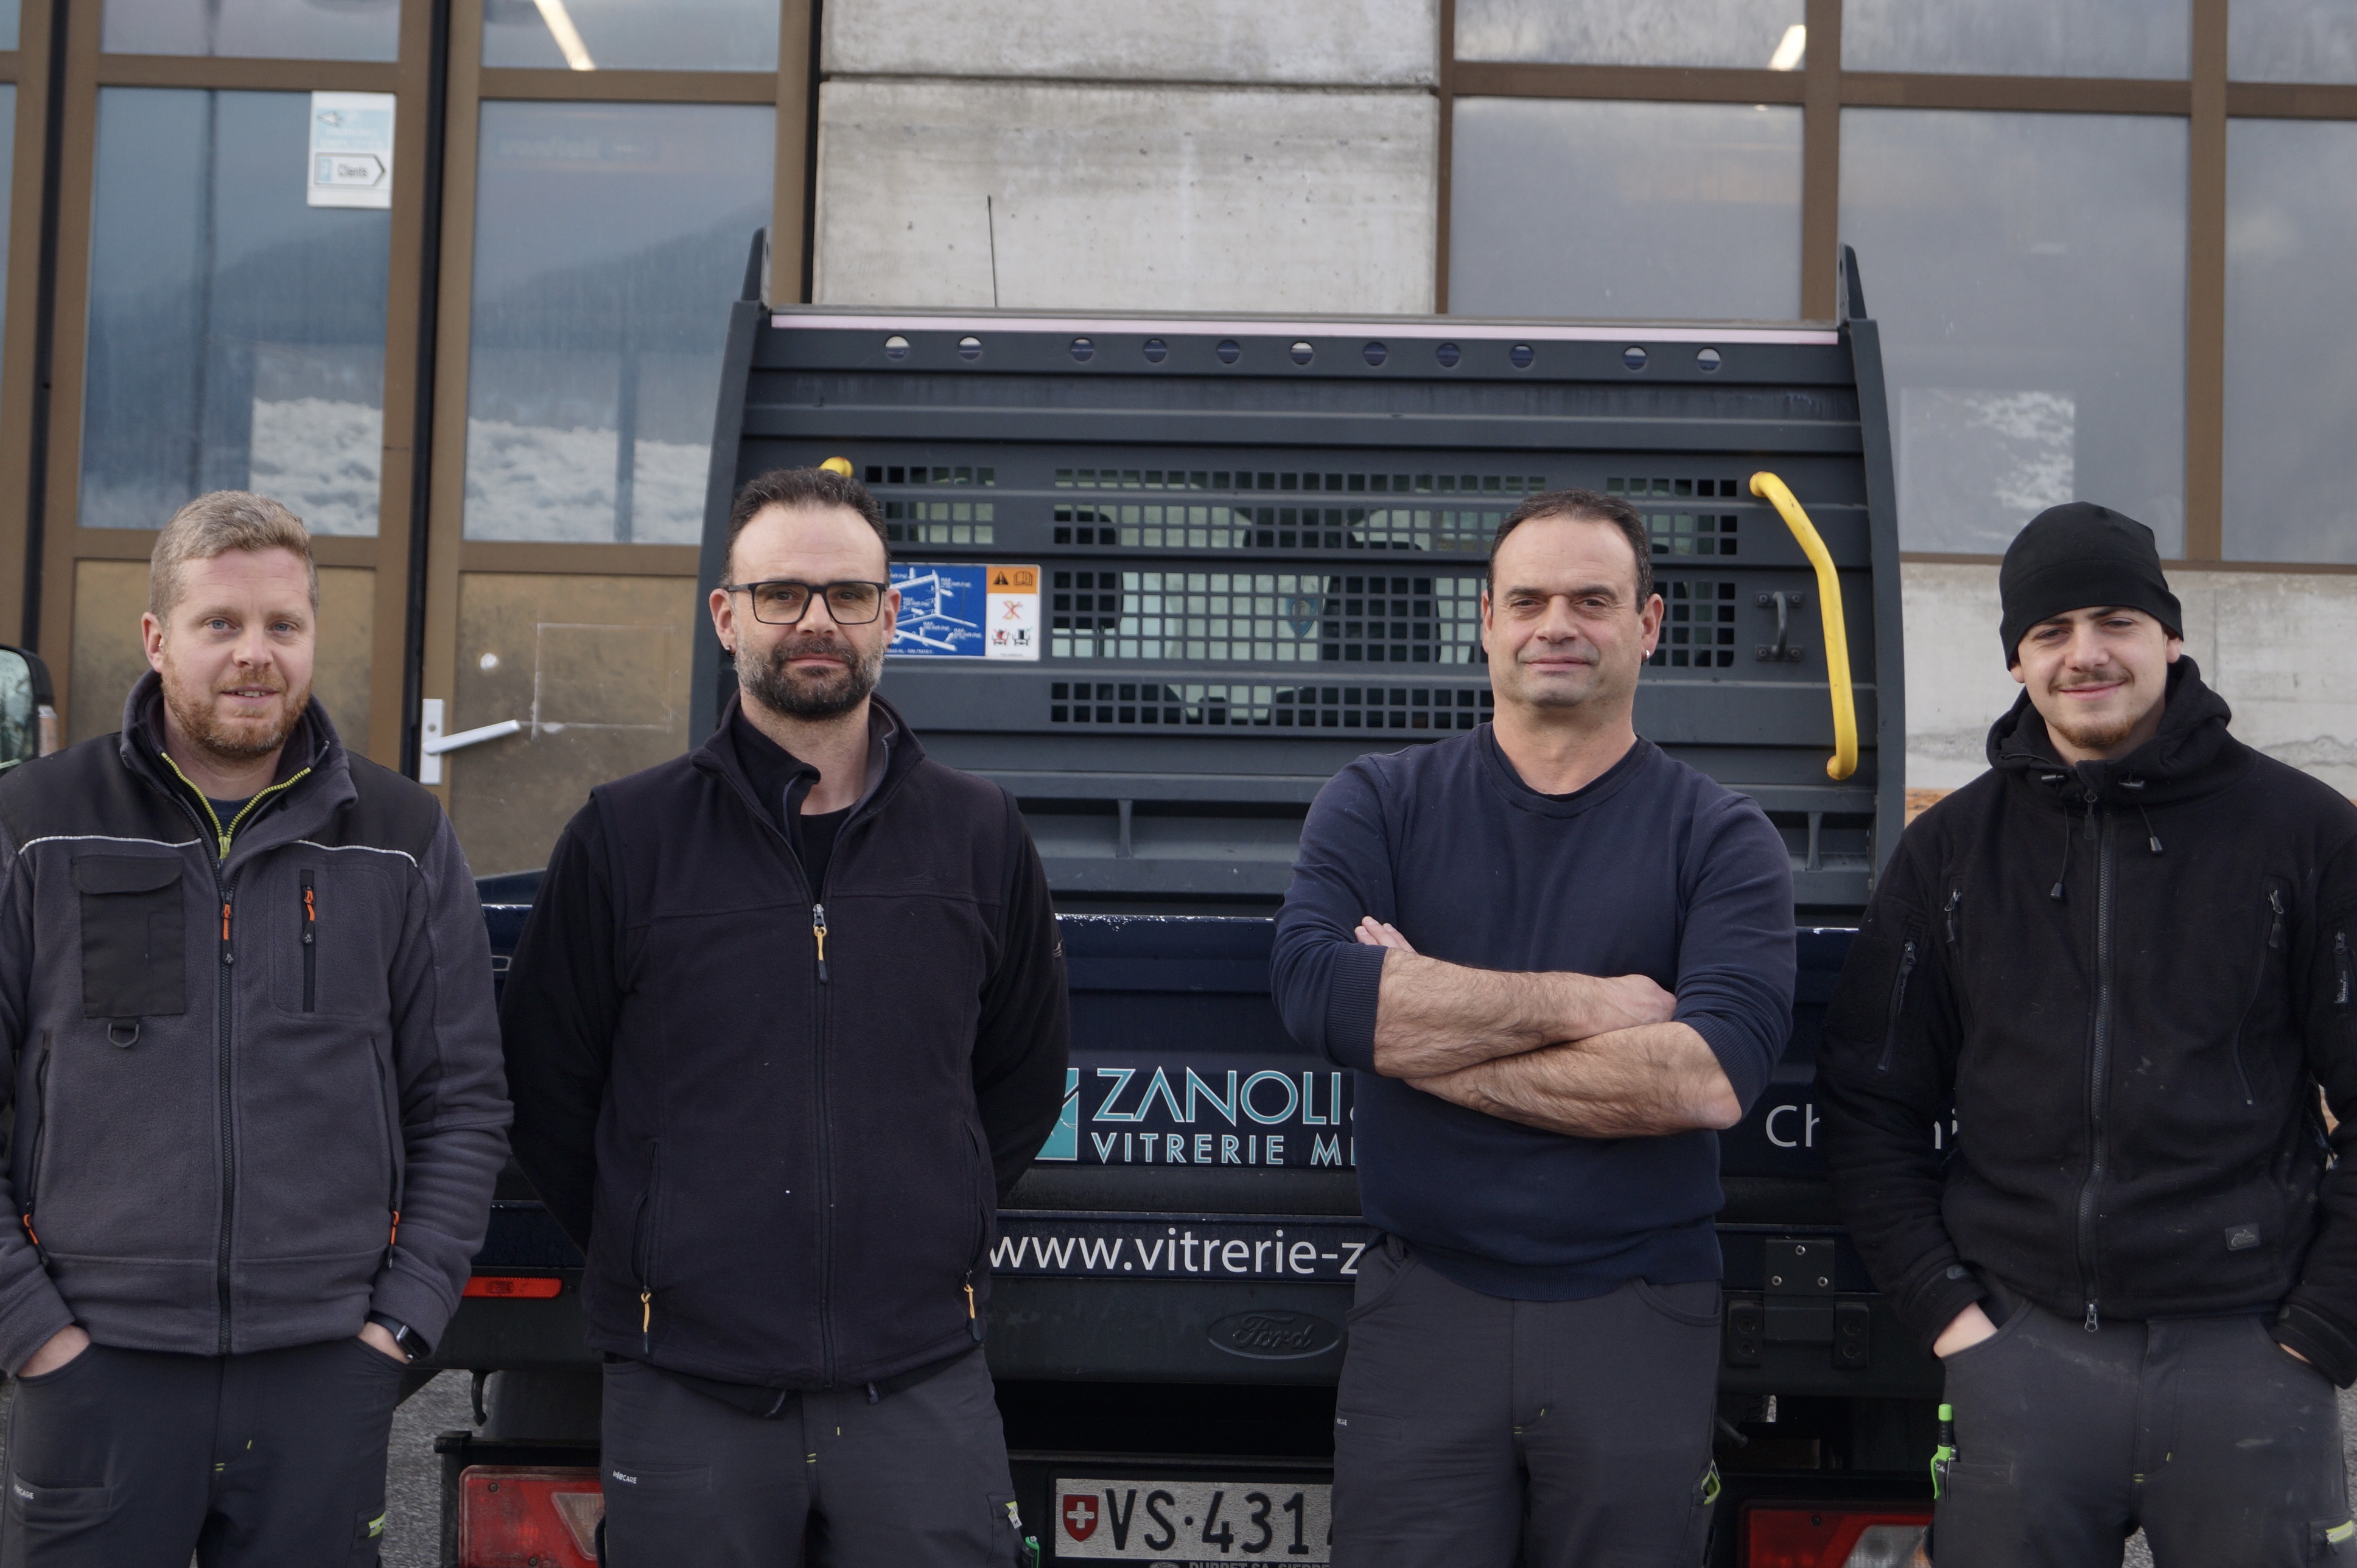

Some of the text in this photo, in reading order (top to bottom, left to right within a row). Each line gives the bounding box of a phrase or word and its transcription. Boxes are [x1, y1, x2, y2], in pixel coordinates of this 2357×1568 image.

[337, 163, 369, 178] Clients
[1092, 1066, 1341, 1126] ZANOLI
[1091, 1132, 1284, 1165] VITRERIE
[1233, 1312, 1315, 1351] Ford
[1105, 1488, 1333, 1555] VS·431
